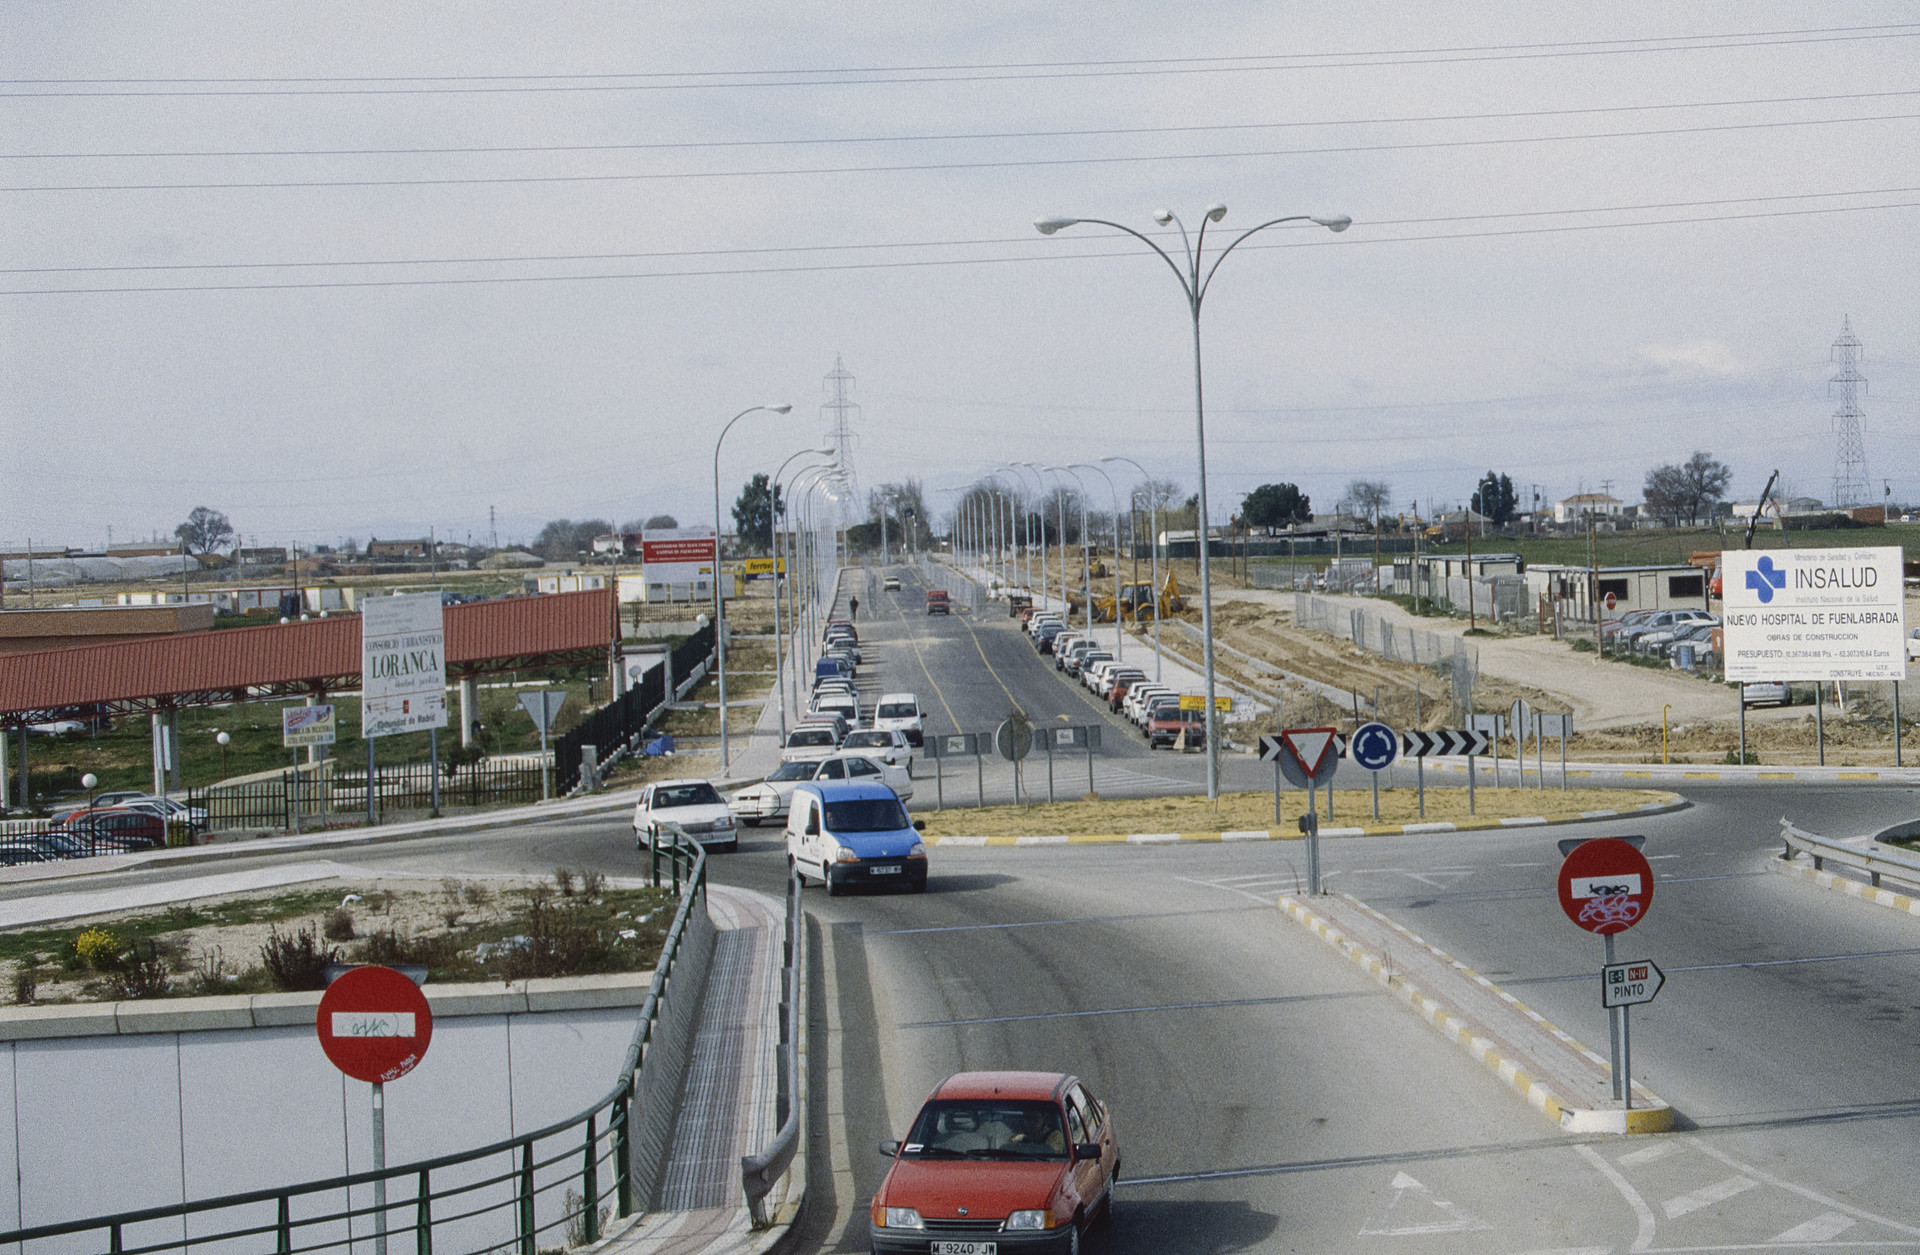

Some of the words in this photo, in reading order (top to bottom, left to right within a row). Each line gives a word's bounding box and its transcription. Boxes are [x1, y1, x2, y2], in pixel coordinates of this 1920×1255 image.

[1795, 567, 1877, 588] INSALUD
[1727, 614, 1757, 626] NUEVO
[1762, 614, 1807, 625] HOSPITAL
[1812, 613, 1824, 624] DE
[1829, 612, 1899, 624] FUENLABRADA
[371, 650, 438, 678] LORANCA
[1610, 971, 1623, 983] E-5
[1629, 968, 1647, 980] N-IV
[1614, 983, 1644, 998] PINTO
